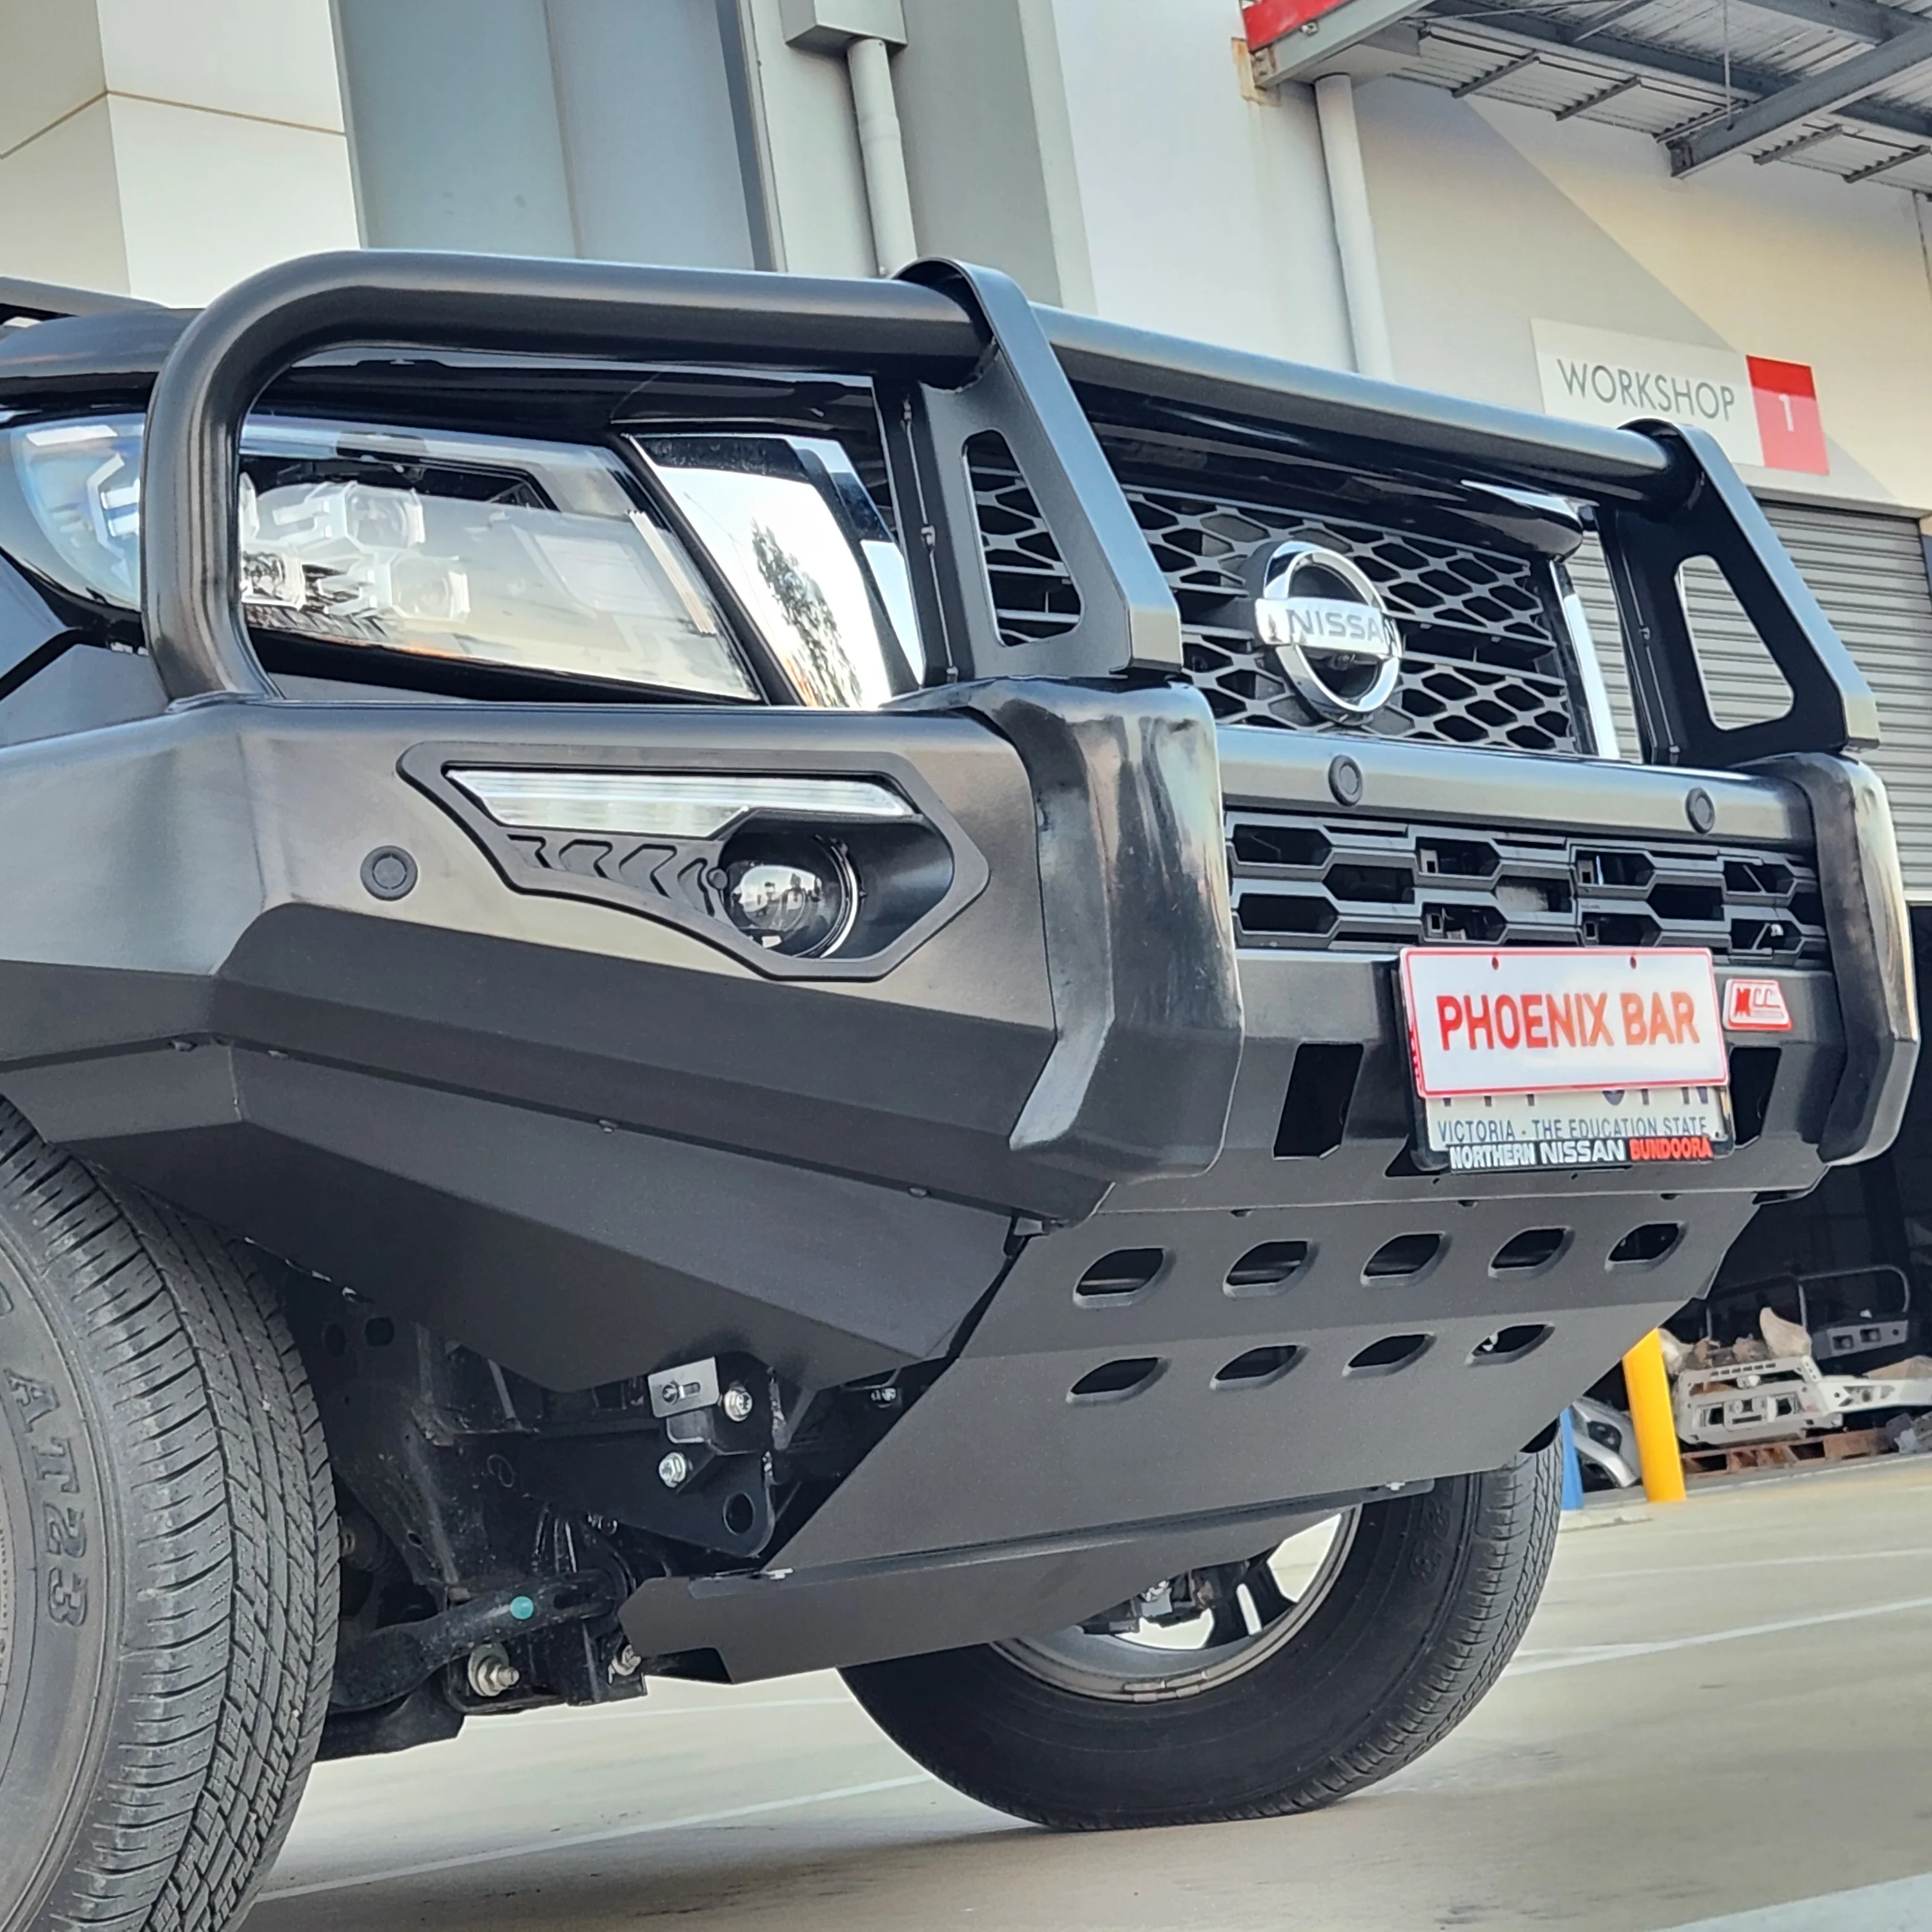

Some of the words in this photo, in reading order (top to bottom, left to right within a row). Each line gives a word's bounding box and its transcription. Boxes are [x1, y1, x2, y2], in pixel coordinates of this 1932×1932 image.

[1557, 358, 1735, 422] WORKSHOP
[1778, 393, 1795, 433] 1
[1286, 608, 1399, 655] NISSAN
[1436, 992, 1614, 1051] PHOENIX
[1619, 991, 1700, 1046] BAR
[1437, 1119, 1516, 1143] VICTORIA
[1532, 1119, 1563, 1140] THE
[1568, 1116, 1658, 1138] EDUCATION
[1663, 1116, 1707, 1135] STATE
[1450, 1142, 1536, 1169] NORTHERN
[1540, 1138, 1626, 1164] NISSAN
[1629, 1136, 1714, 1161] BUNDOORA
